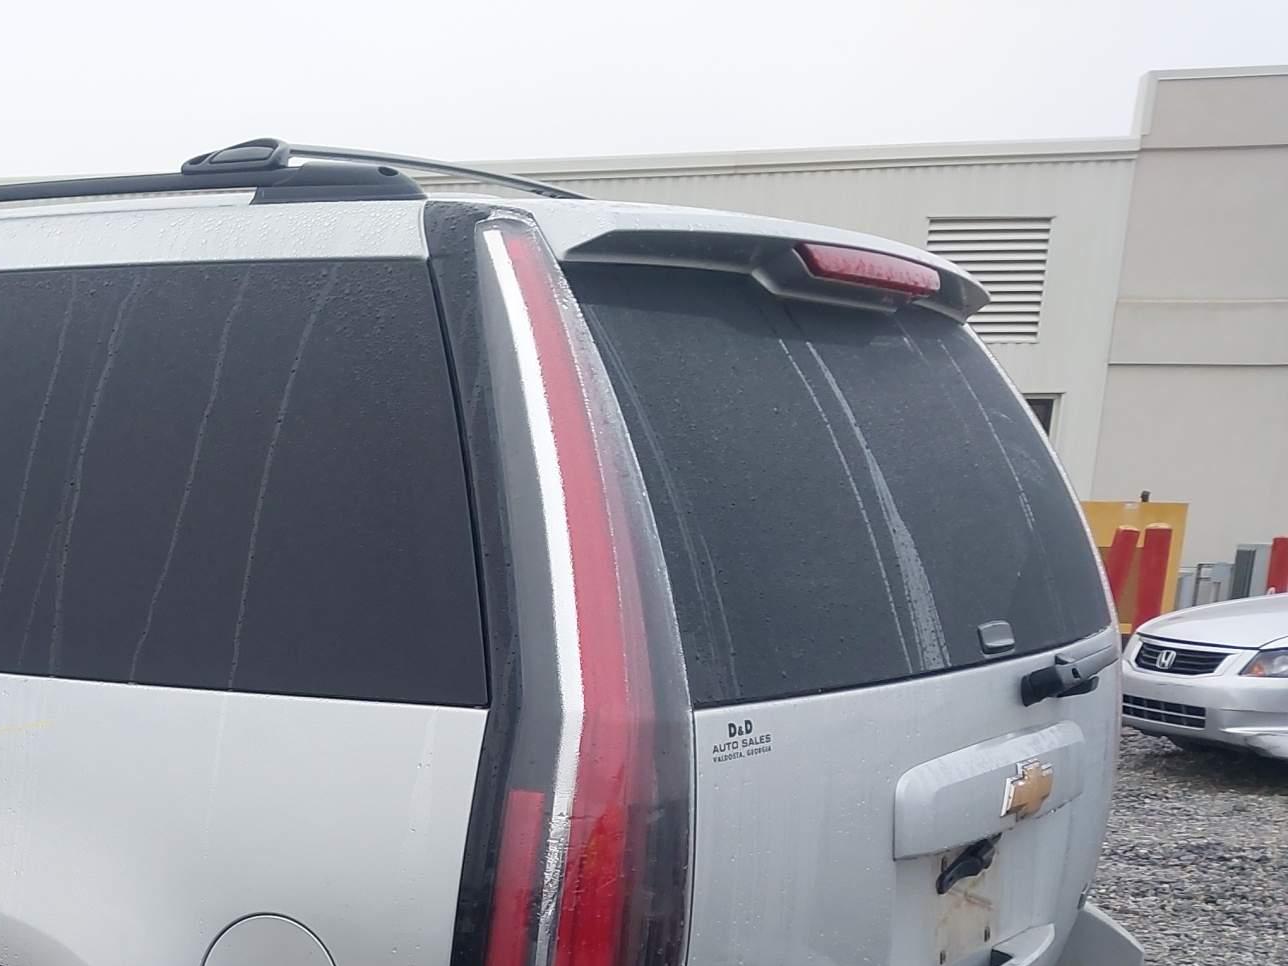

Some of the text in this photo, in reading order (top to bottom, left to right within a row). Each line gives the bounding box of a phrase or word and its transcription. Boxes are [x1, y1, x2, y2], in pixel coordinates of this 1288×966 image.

[727, 719, 753, 738] D&D
[712, 733, 771, 754] AUTO SALES
